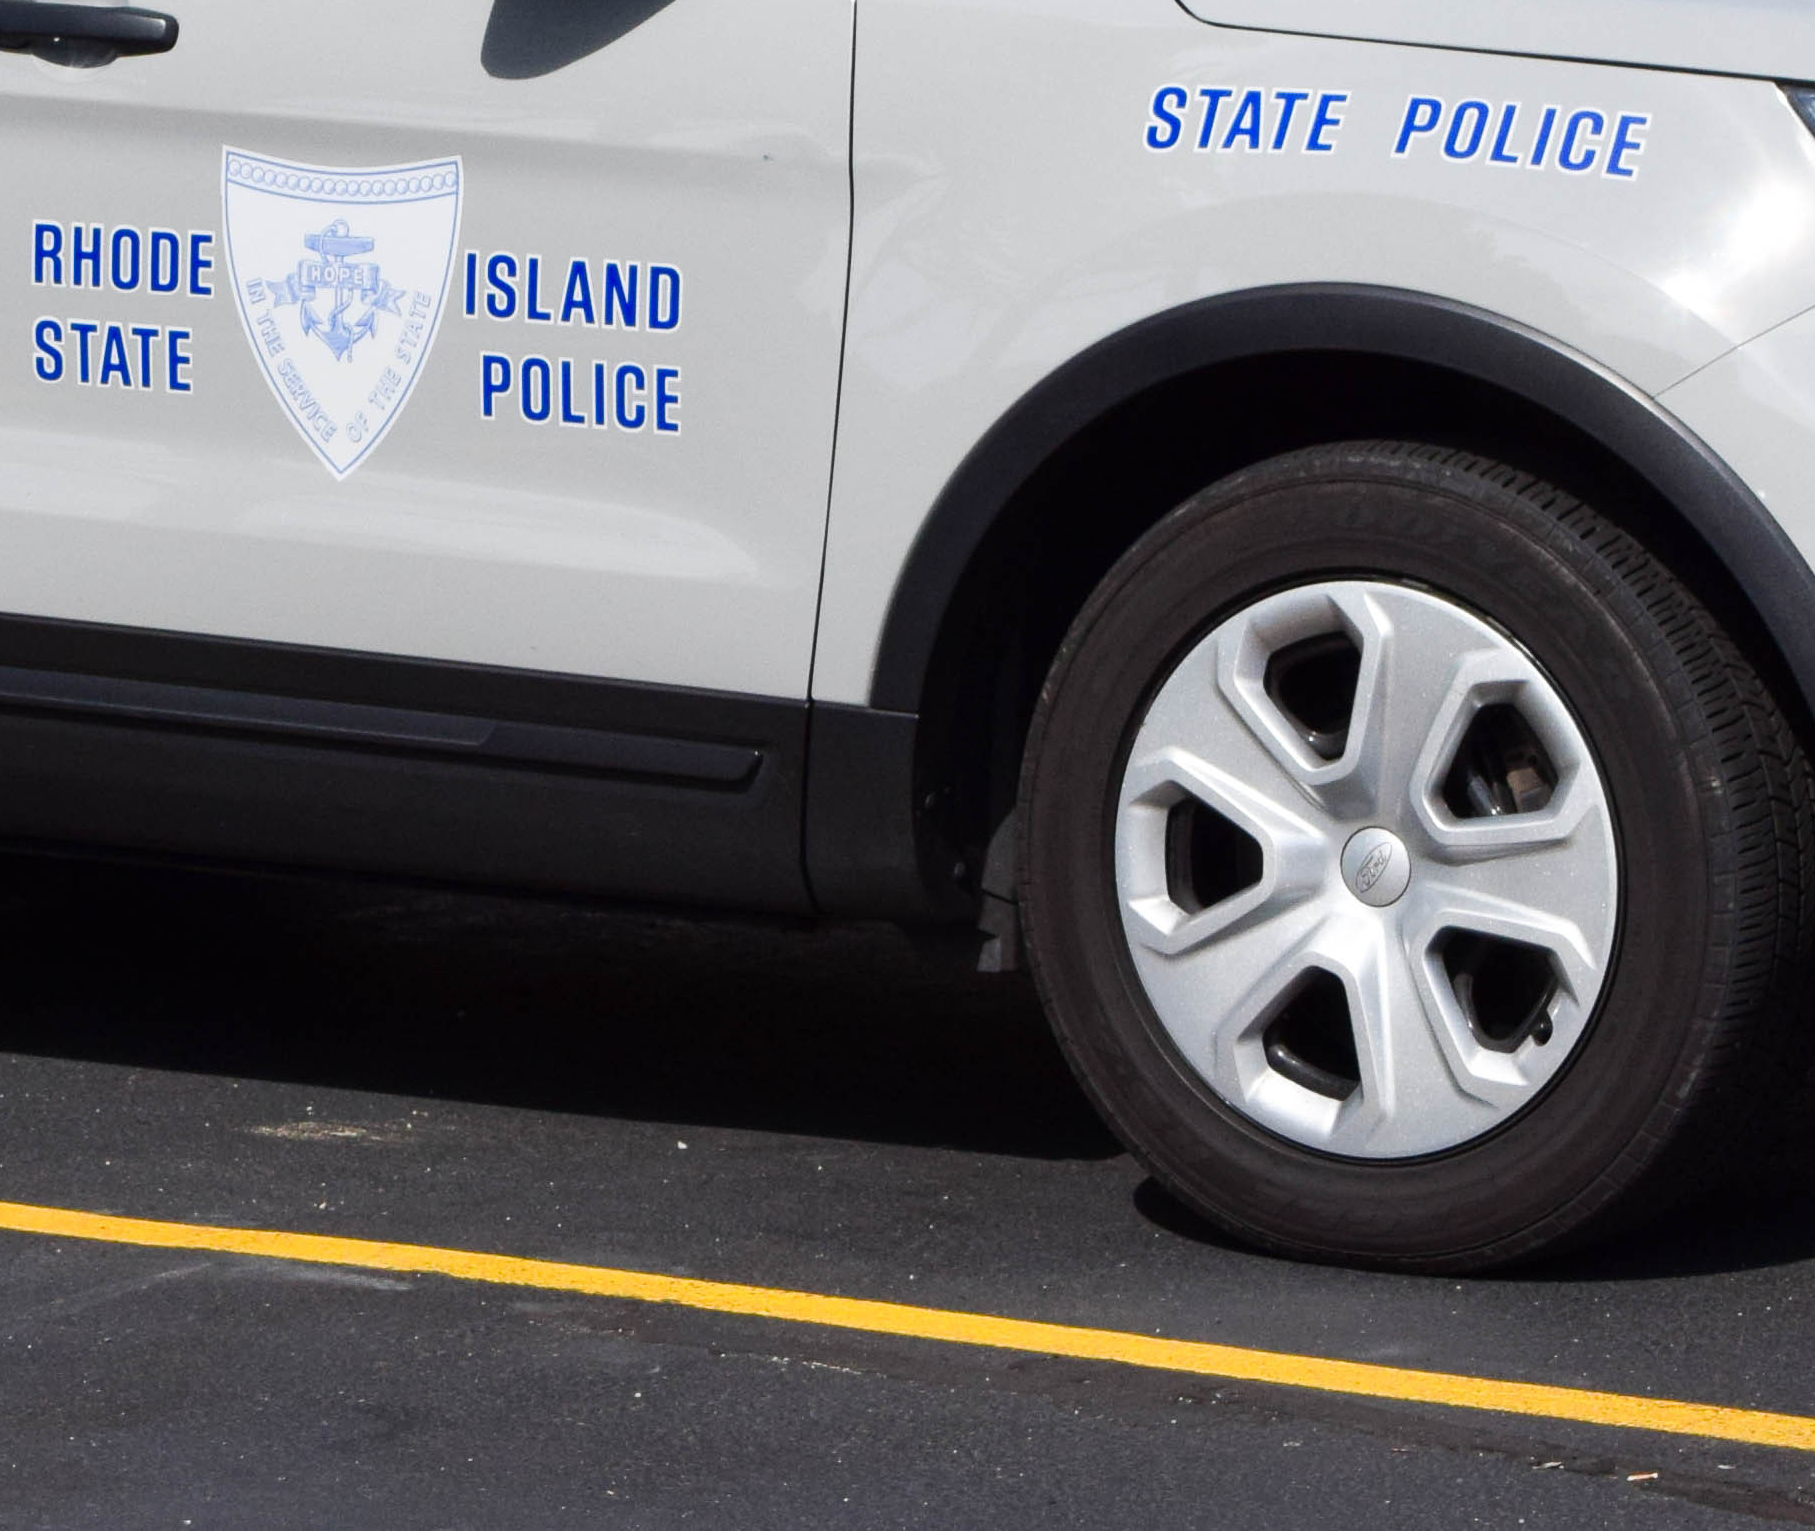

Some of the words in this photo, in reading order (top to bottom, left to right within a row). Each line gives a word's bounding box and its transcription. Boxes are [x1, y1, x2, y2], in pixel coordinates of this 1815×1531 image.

[1145, 85, 1348, 153] STATE
[1393, 95, 1648, 178] POLICE
[33, 221, 214, 297] RHODE
[311, 266, 364, 286] HOPE
[465, 251, 682, 331] ISLAND
[33, 319, 192, 392] STATE
[246, 277, 266, 305] IN
[257, 309, 285, 357] THE
[277, 358, 338, 443] SERVICE
[345, 411, 369, 444] OF
[368, 366, 402, 411] THE
[395, 291, 432, 365] STATE
[481, 354, 680, 433] POLICE
